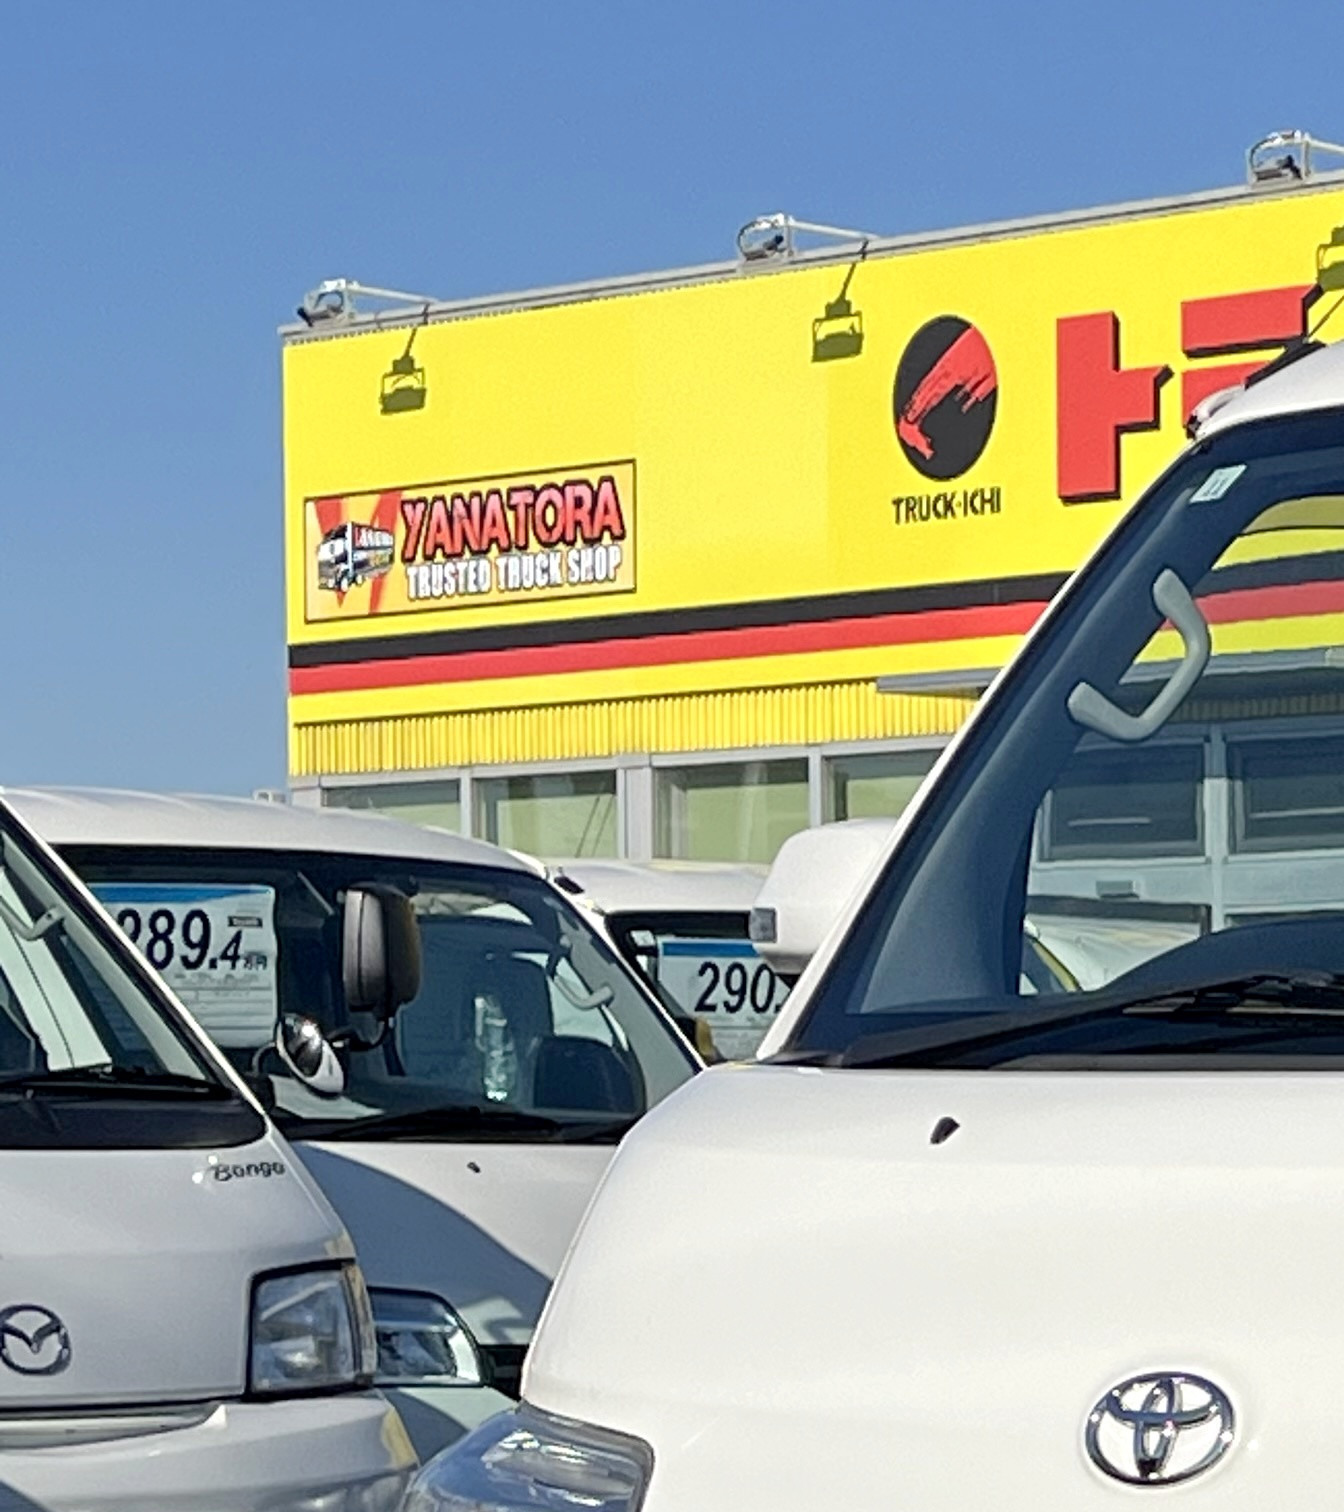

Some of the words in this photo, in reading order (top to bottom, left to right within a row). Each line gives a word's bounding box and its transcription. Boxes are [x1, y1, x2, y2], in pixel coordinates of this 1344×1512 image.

[401, 475, 626, 563] YANATORA
[405, 555, 492, 600] TRUSTED
[495, 550, 563, 592] TRUCK
[566, 543, 623, 584] SHOP
[207, 1162, 285, 1182] Bongo
